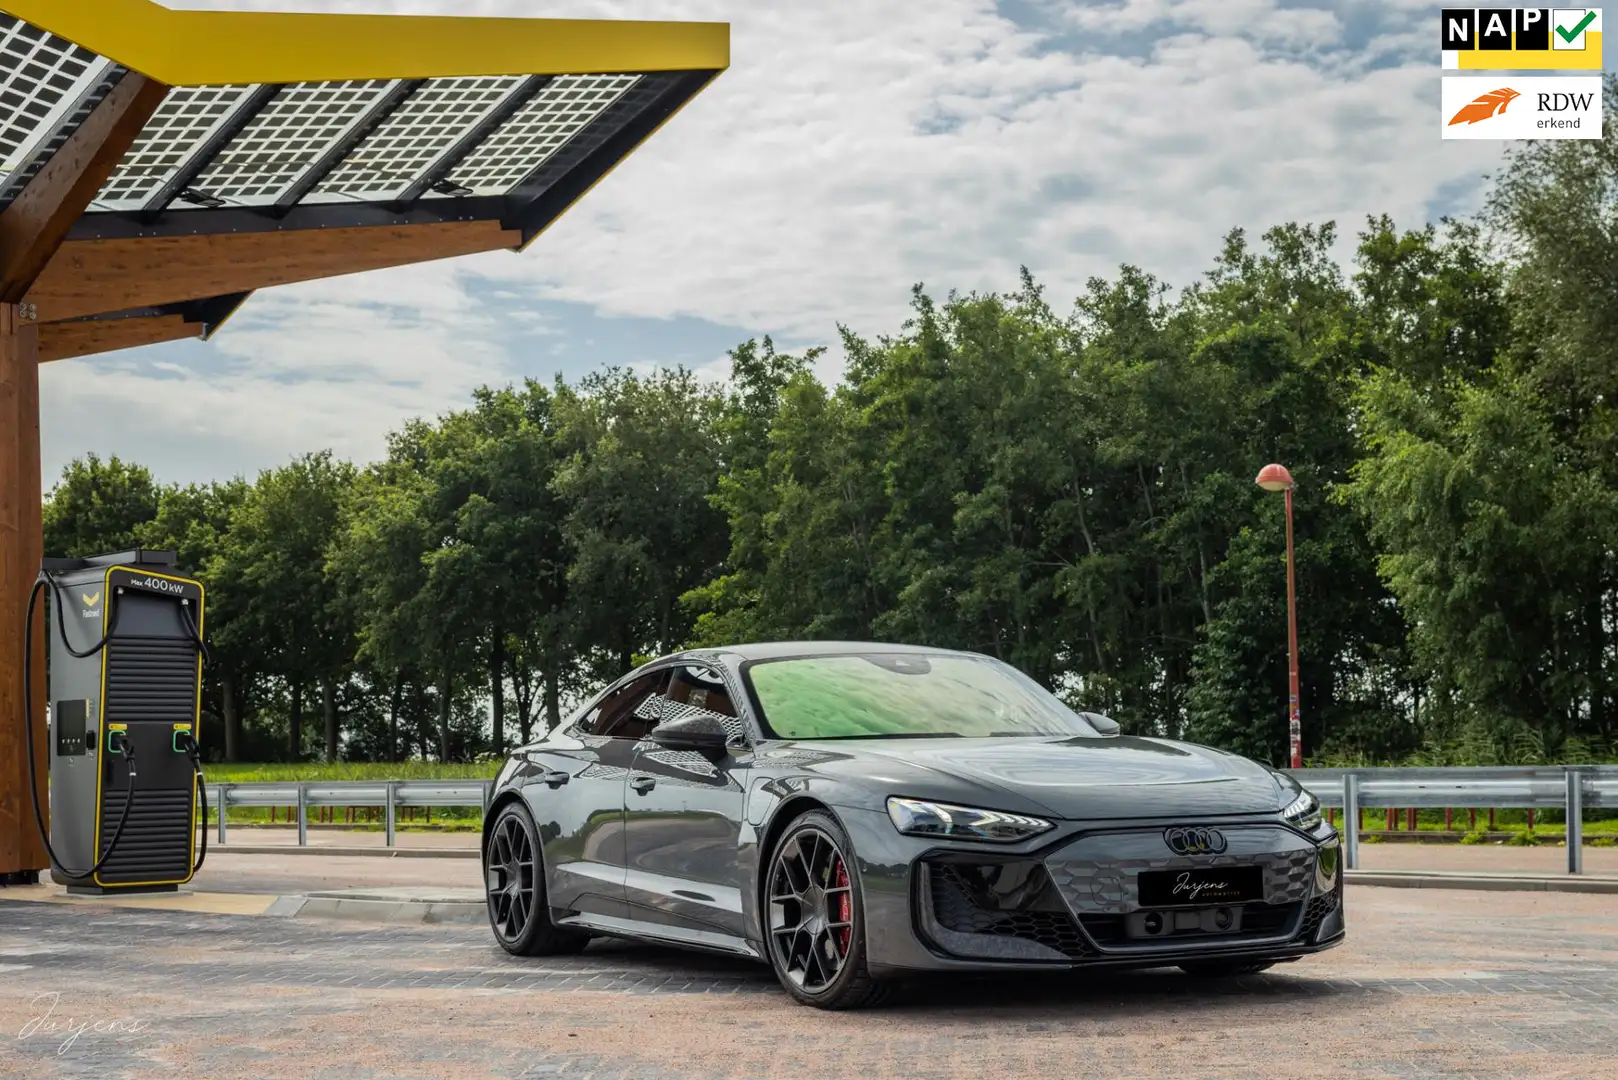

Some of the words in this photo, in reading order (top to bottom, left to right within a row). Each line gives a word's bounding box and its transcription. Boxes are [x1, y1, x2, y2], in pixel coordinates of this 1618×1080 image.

[130, 578, 143, 587] Max
[144, 577, 168, 591] 400
[169, 583, 184, 594] kW
[1172, 872, 1228, 899] Jurjens
